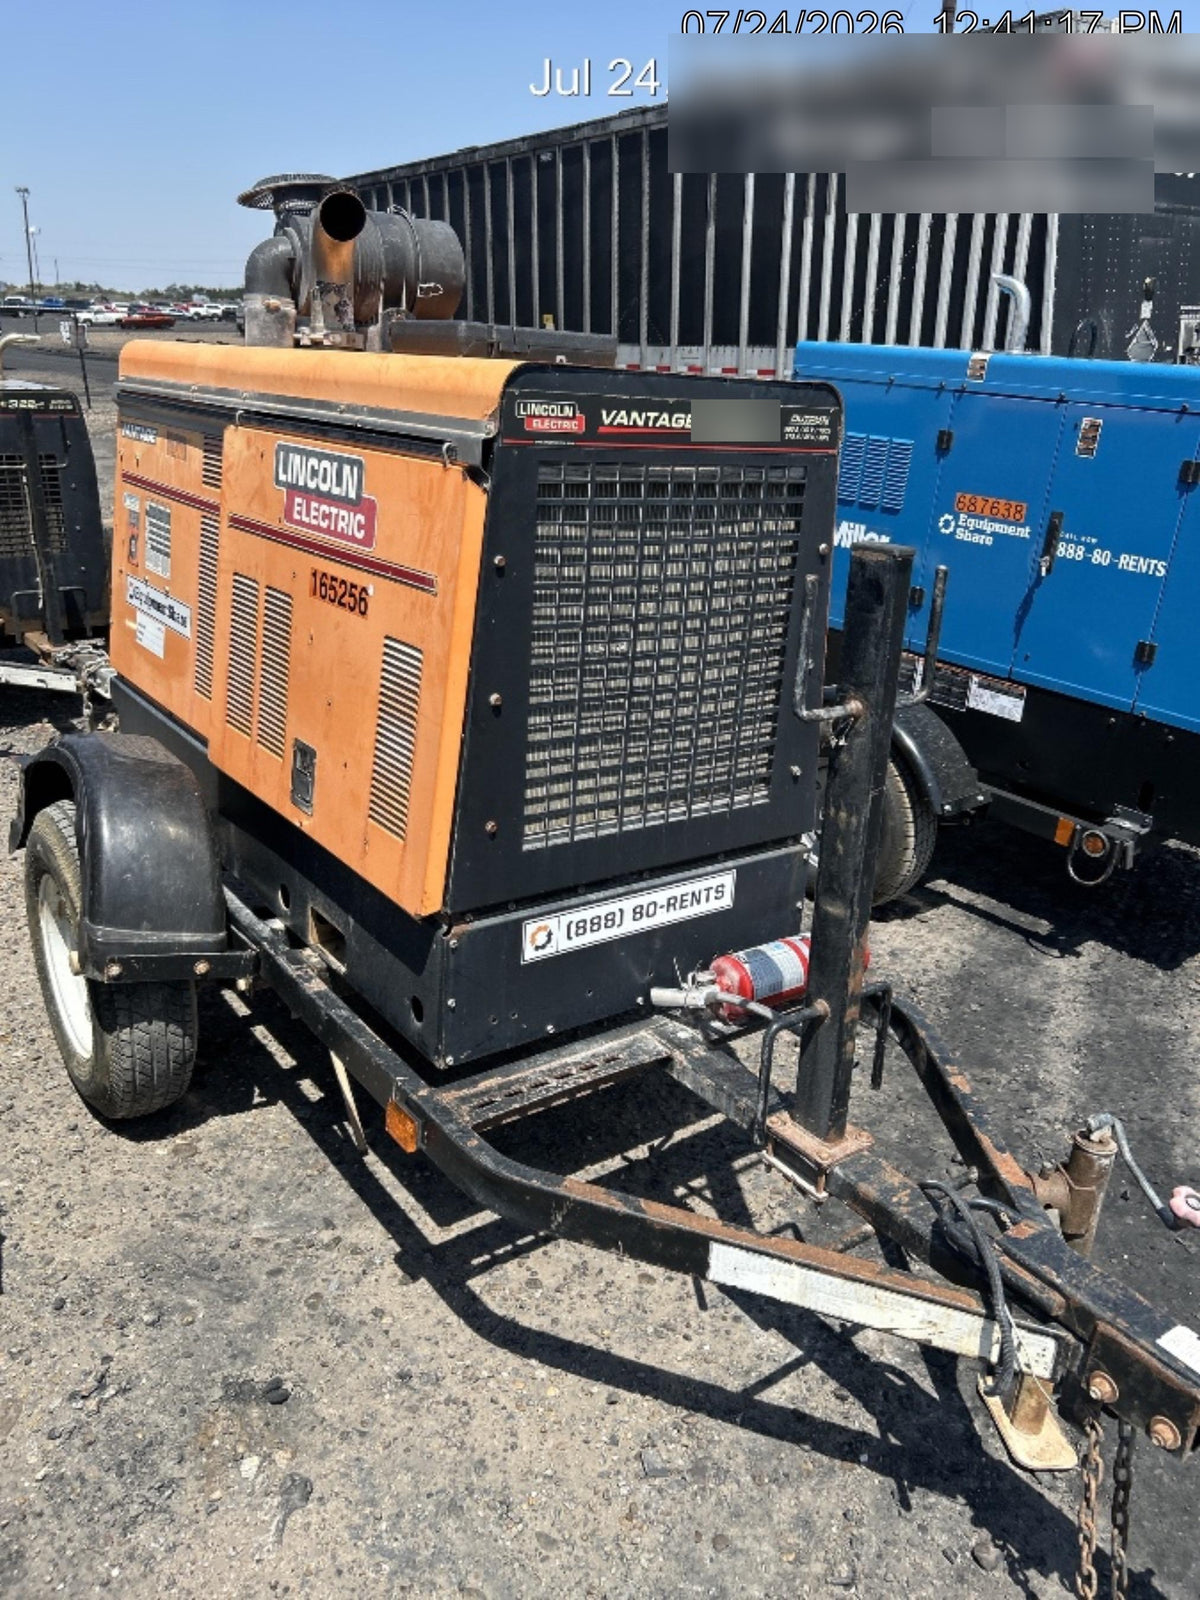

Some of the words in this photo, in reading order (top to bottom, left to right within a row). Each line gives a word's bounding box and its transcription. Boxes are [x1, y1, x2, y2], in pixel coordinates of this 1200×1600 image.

[520, 403, 573, 417] LINCOLN
[532, 419, 579, 429] ELECTRIC
[278, 451, 358, 499] LINCOLN
[293, 497, 365, 539] ELECTRIC
[956, 495, 1024, 521] 687638
[955, 527, 993, 546] Share
[958, 513, 1030, 538] Equipment
[311, 570, 369, 615] 165256
[566, 908, 625, 940] (888)
[632, 883, 726, 922] 80-RENTS
